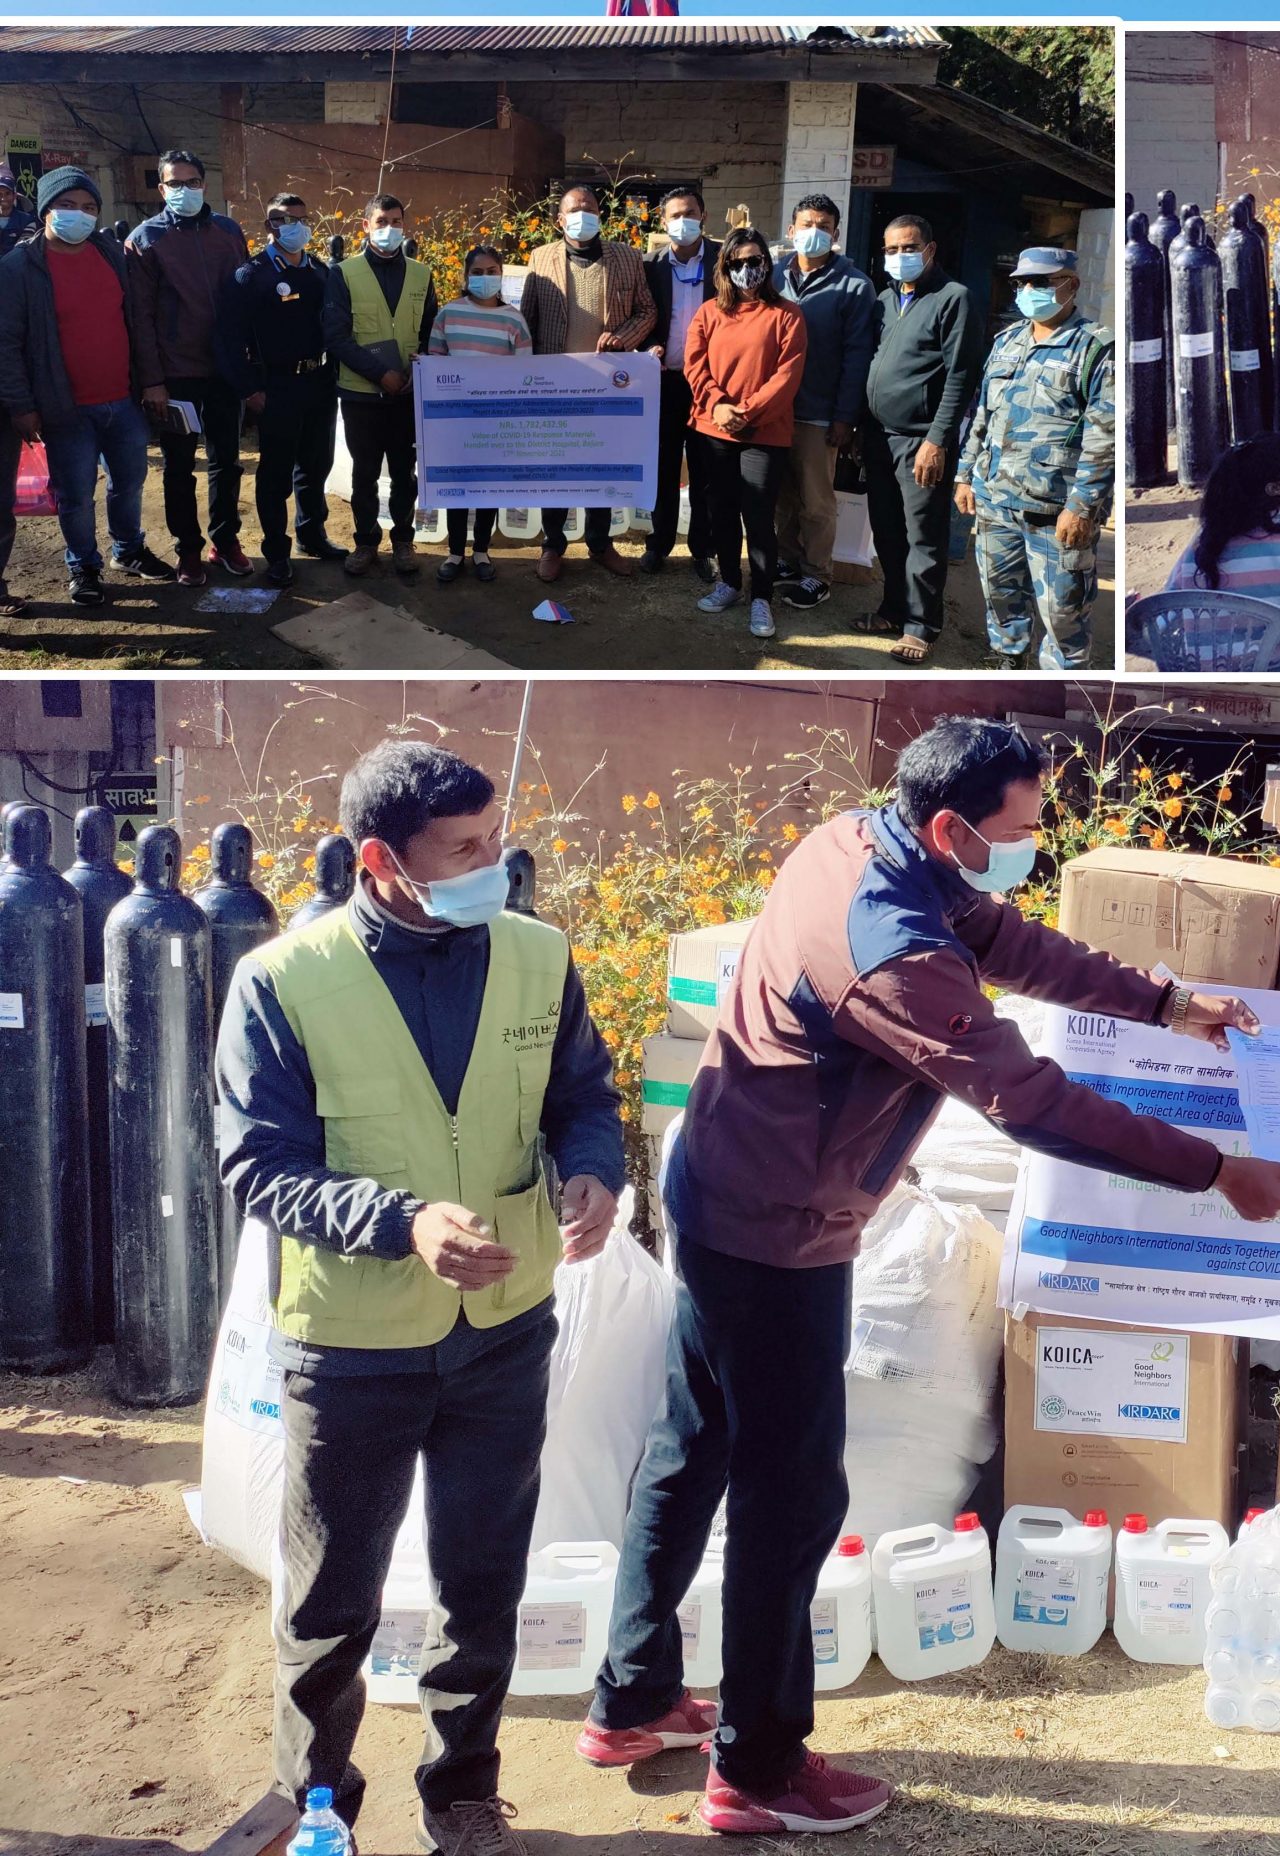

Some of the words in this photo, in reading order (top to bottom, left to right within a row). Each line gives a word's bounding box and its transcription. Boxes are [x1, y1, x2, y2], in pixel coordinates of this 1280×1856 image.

[11, 140, 37, 150] DANGER
[45, 151, 72, 163] X-Ray
[853, 152, 888, 169] SD
[851, 176, 877, 184] om
[436, 375, 461, 384] KOICA
[1067, 1015, 1117, 1039] KOICA
[514, 1041, 533, 1052] Good
[1083, 1039, 1116, 1050] International
[1065, 1045, 1096, 1055] Cooperation
[1097, 1048, 1116, 1057] Agency
[1173, 1064, 1193, 1076] राहत
[1196, 1065, 1234, 1079] सामाजिक
[1113, 1082, 1184, 1102] Improvement
[1187, 1090, 1222, 1106] Project
[1135, 1103, 1173, 1120] Project
[1175, 1107, 1200, 1121] Area
[1202, 1108, 1214, 1123] of
[1216, 1110, 1246, 1125] Bajur
[1190, 1201, 1217, 1218] 17th
[1040, 1225, 1068, 1245] Good
[1070, 1228, 1129, 1248] Neighbors
[1126, 1236, 1194, 1253] International
[1196, 1241, 1233, 1257] Stands
[1206, 1258, 1247, 1275] against
[1037, 1270, 1099, 1293] KIRDARC
[226, 1329, 246, 1354] KOICA
[1043, 1345, 1093, 1365] KOICA
[1134, 1360, 1153, 1372] Good
[1134, 1367, 1172, 1380] Neighbors
[1134, 1376, 1170, 1388] International
[249, 1398, 281, 1419] KIRDA
[1067, 1408, 1102, 1418] PeaceWin
[1117, 1403, 1181, 1421] KIRDARC
[1025, 1570, 1044, 1579] KOICA
[1139, 1580, 1158, 1588] KOICA
[917, 1588, 937, 1599] KOICA
[523, 1618, 545, 1627] KOICA
